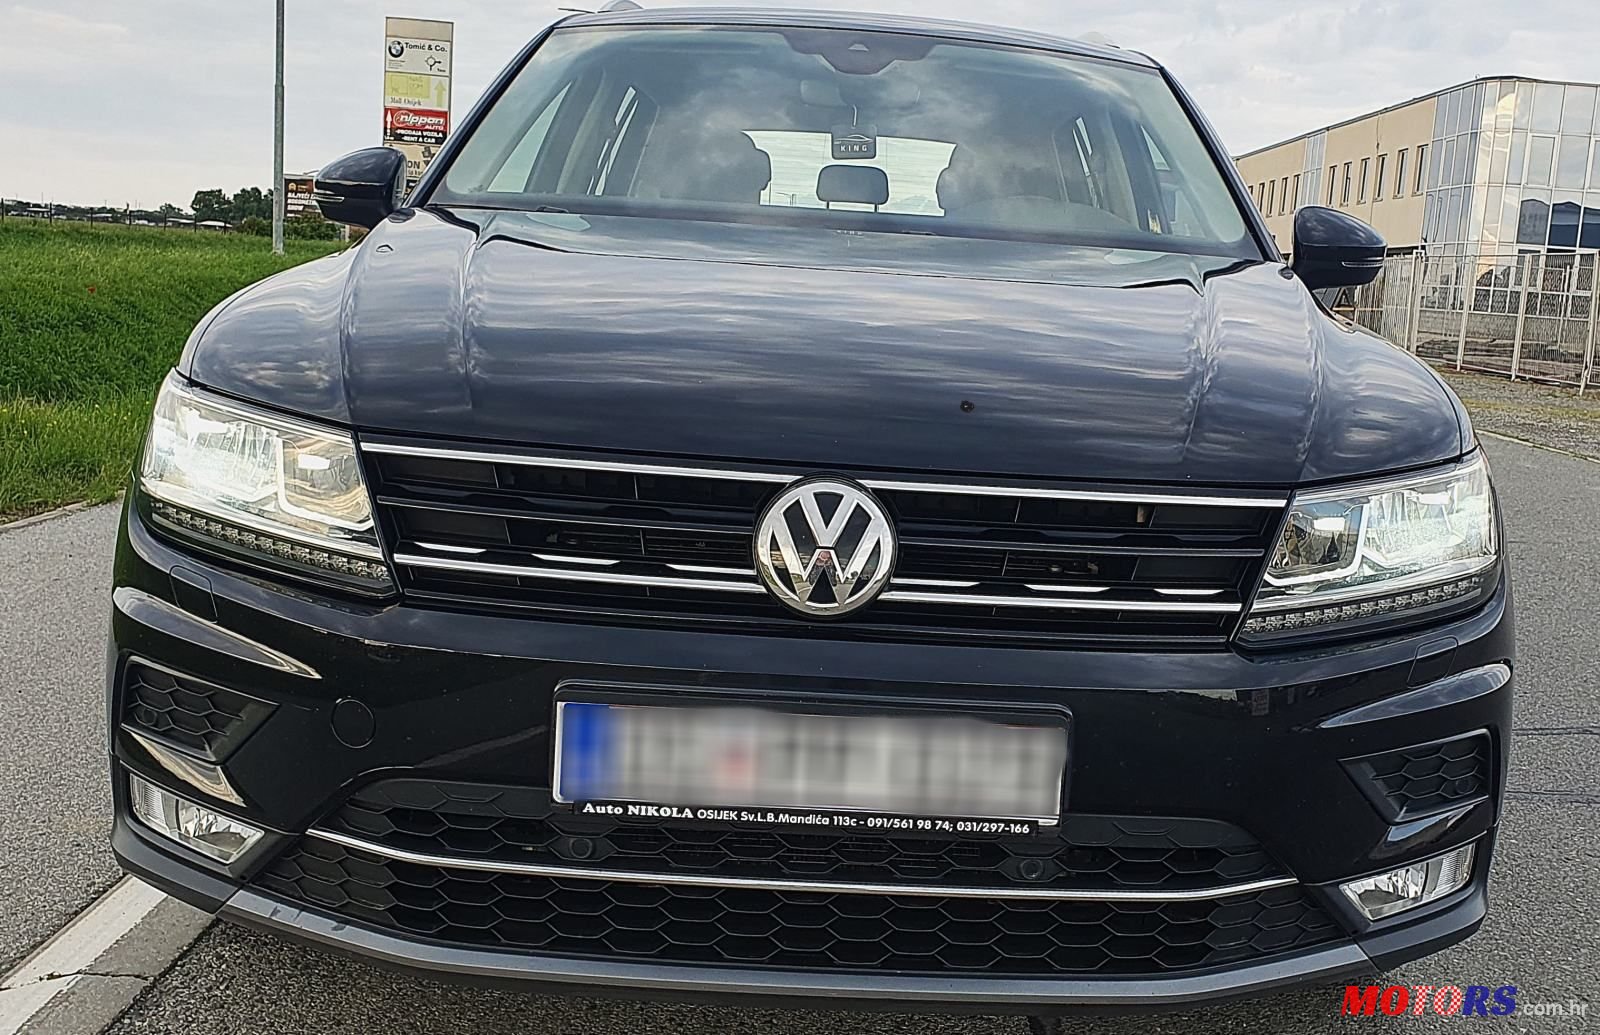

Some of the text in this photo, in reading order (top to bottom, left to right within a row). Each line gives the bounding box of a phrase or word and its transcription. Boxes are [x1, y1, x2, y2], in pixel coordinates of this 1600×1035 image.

[404, 42, 426, 50] Tomić
[399, 113, 445, 125] nippon
[840, 144, 868, 152] KING
[582, 803, 623, 815] Auto
[627, 805, 694, 819] NIKOLA
[697, 809, 738, 821] OSIJEK
[740, 811, 830, 825] Sv.L.B.Mandića
[833, 816, 857, 827] 113c
[867, 817, 913, 829] 091/561
[916, 819, 931, 830] 98
[935, 820, 953, 832] 74;
[956, 821, 1030, 834] 031/297-166
